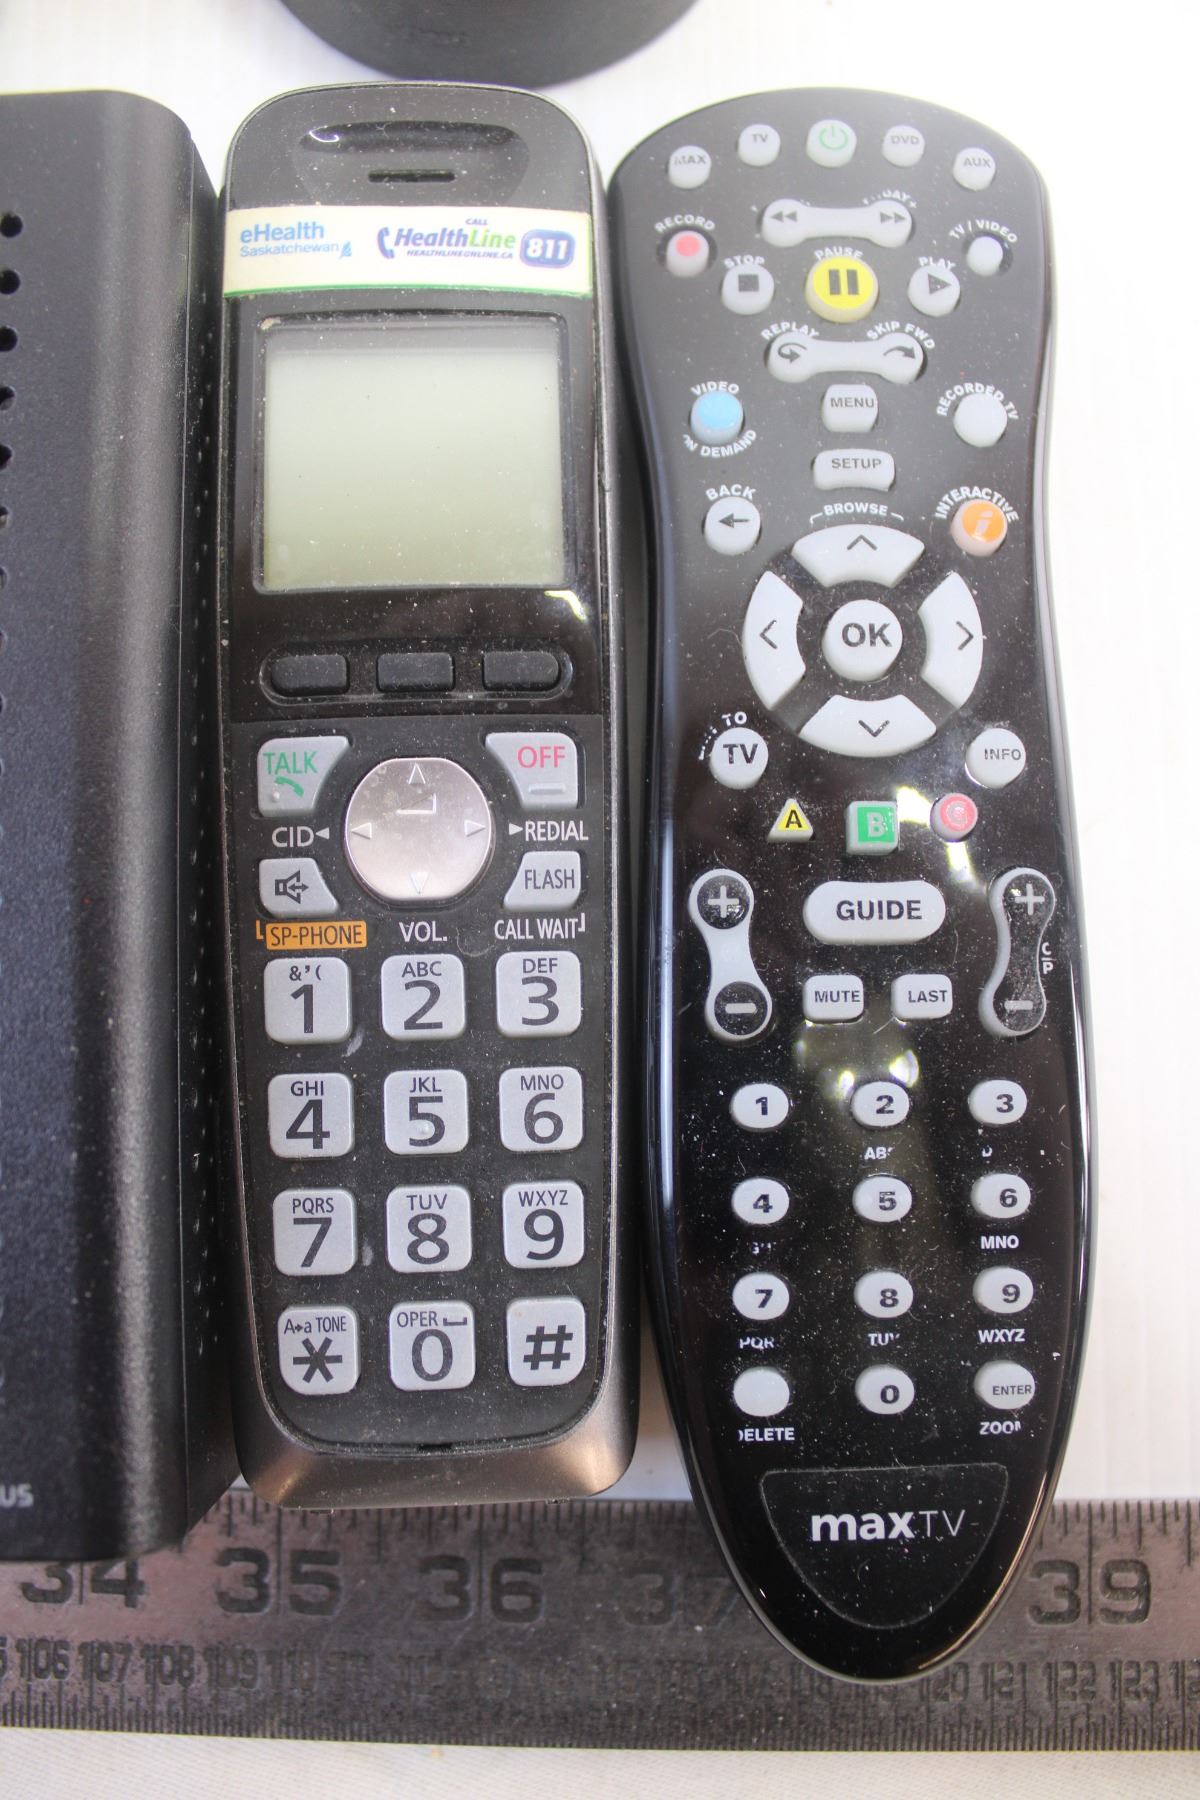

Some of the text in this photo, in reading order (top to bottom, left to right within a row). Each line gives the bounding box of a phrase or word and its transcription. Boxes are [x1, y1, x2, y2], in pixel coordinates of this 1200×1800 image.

[751, 133, 769, 143] TV
[890, 134, 920, 145] DVD
[673, 154, 707, 166] MAX
[963, 157, 992, 169] AUX
[240, 221, 325, 243] eHealth
[465, 217, 489, 226] CALL
[654, 214, 716, 233] RECORD
[949, 224, 965, 240] TV
[975, 219, 1018, 243] VIDEO
[394, 227, 516, 249] HealthLine
[240, 243, 340, 258] Saskatchewan
[526, 238, 568, 261] 811
[814, 245, 864, 261] PAUSE
[723, 254, 766, 269] STOP
[918, 256, 956, 272] PLAY
[760, 321, 820, 341] REPLAY
[866, 320, 936, 350] SKIP FWD
[690, 380, 740, 397] VIDEO
[829, 396, 876, 409] MENU
[936, 382, 1020, 420] RECORDED TV
[700, 429, 757, 458] DEMAND
[831, 457, 882, 470] SETUP
[705, 484, 756, 501] BACK
[823, 503, 889, 517] BROWSE
[935, 487, 1019, 523] INTERACTIVE
[841, 622, 893, 648] OK
[721, 711, 748, 727] TO
[263, 751, 319, 777] TALK
[517, 745, 566, 770] OFF
[722, 743, 759, 765] TV
[983, 748, 1022, 761] INFO
[785, 809, 804, 829] A
[866, 813, 886, 837] B
[271, 826, 315, 849] CID
[524, 819, 589, 842] REDIAL
[523, 868, 576, 890] FLASH
[835, 899, 923, 921] GUIDE
[269, 924, 364, 947] SP-PHONE
[399, 921, 448, 943] VOL.
[494, 917, 578, 941] CALL WAIT
[400, 960, 443, 978] ABC
[521, 957, 559, 974] DEF
[402, 979, 444, 1031] 2
[520, 975, 560, 1027] 3
[813, 990, 861, 1003] MUTE
[907, 990, 948, 1003] LAST
[289, 983, 314, 1034] 1
[289, 1080, 325, 1097] GHI
[409, 1076, 443, 1093] JKL
[520, 1073, 565, 1091] MNO
[755, 1096, 769, 1116] 1
[875, 1095, 895, 1115] 2
[995, 1093, 1015, 1114] 3
[285, 1099, 331, 1150] 4
[408, 1095, 446, 1148] 5
[523, 1092, 565, 1145] 6
[291, 1197, 335, 1215] PQRS
[406, 1193, 448, 1211] TUV
[518, 1189, 569, 1208] WXYZ
[752, 1193, 774, 1214] 4
[878, 1190, 897, 1211] 5
[999, 1187, 1019, 1208] 6
[292, 1217, 333, 1268] 7
[406, 1212, 451, 1266] 8
[523, 1208, 565, 1261] 9
[980, 1235, 1020, 1250] MNO
[754, 1288, 774, 1309] 7
[879, 1288, 900, 1309] 8
[1001, 1283, 1022, 1304] 9
[315, 1315, 347, 1333] TONE
[396, 1310, 439, 1328] OPER
[978, 1328, 1026, 1343] WXYZ
[411, 1328, 454, 1382] 0
[523, 1324, 574, 1371] #
[879, 1384, 901, 1405] 0
[992, 1384, 1033, 1396] ENTER
[215, 1547, 343, 1617] 35
[418, 1554, 544, 1624] 36
[1028, 1559, 1151, 1626] 39
[15, 1638, 70, 1680] 106
[78, 1640, 133, 1682] 107
[140, 1643, 195, 1687] 108
[979, 1661, 1028, 1700] 121
[1042, 1659, 1097, 1701] 122
[1107, 1660, 1160, 1701] 123
